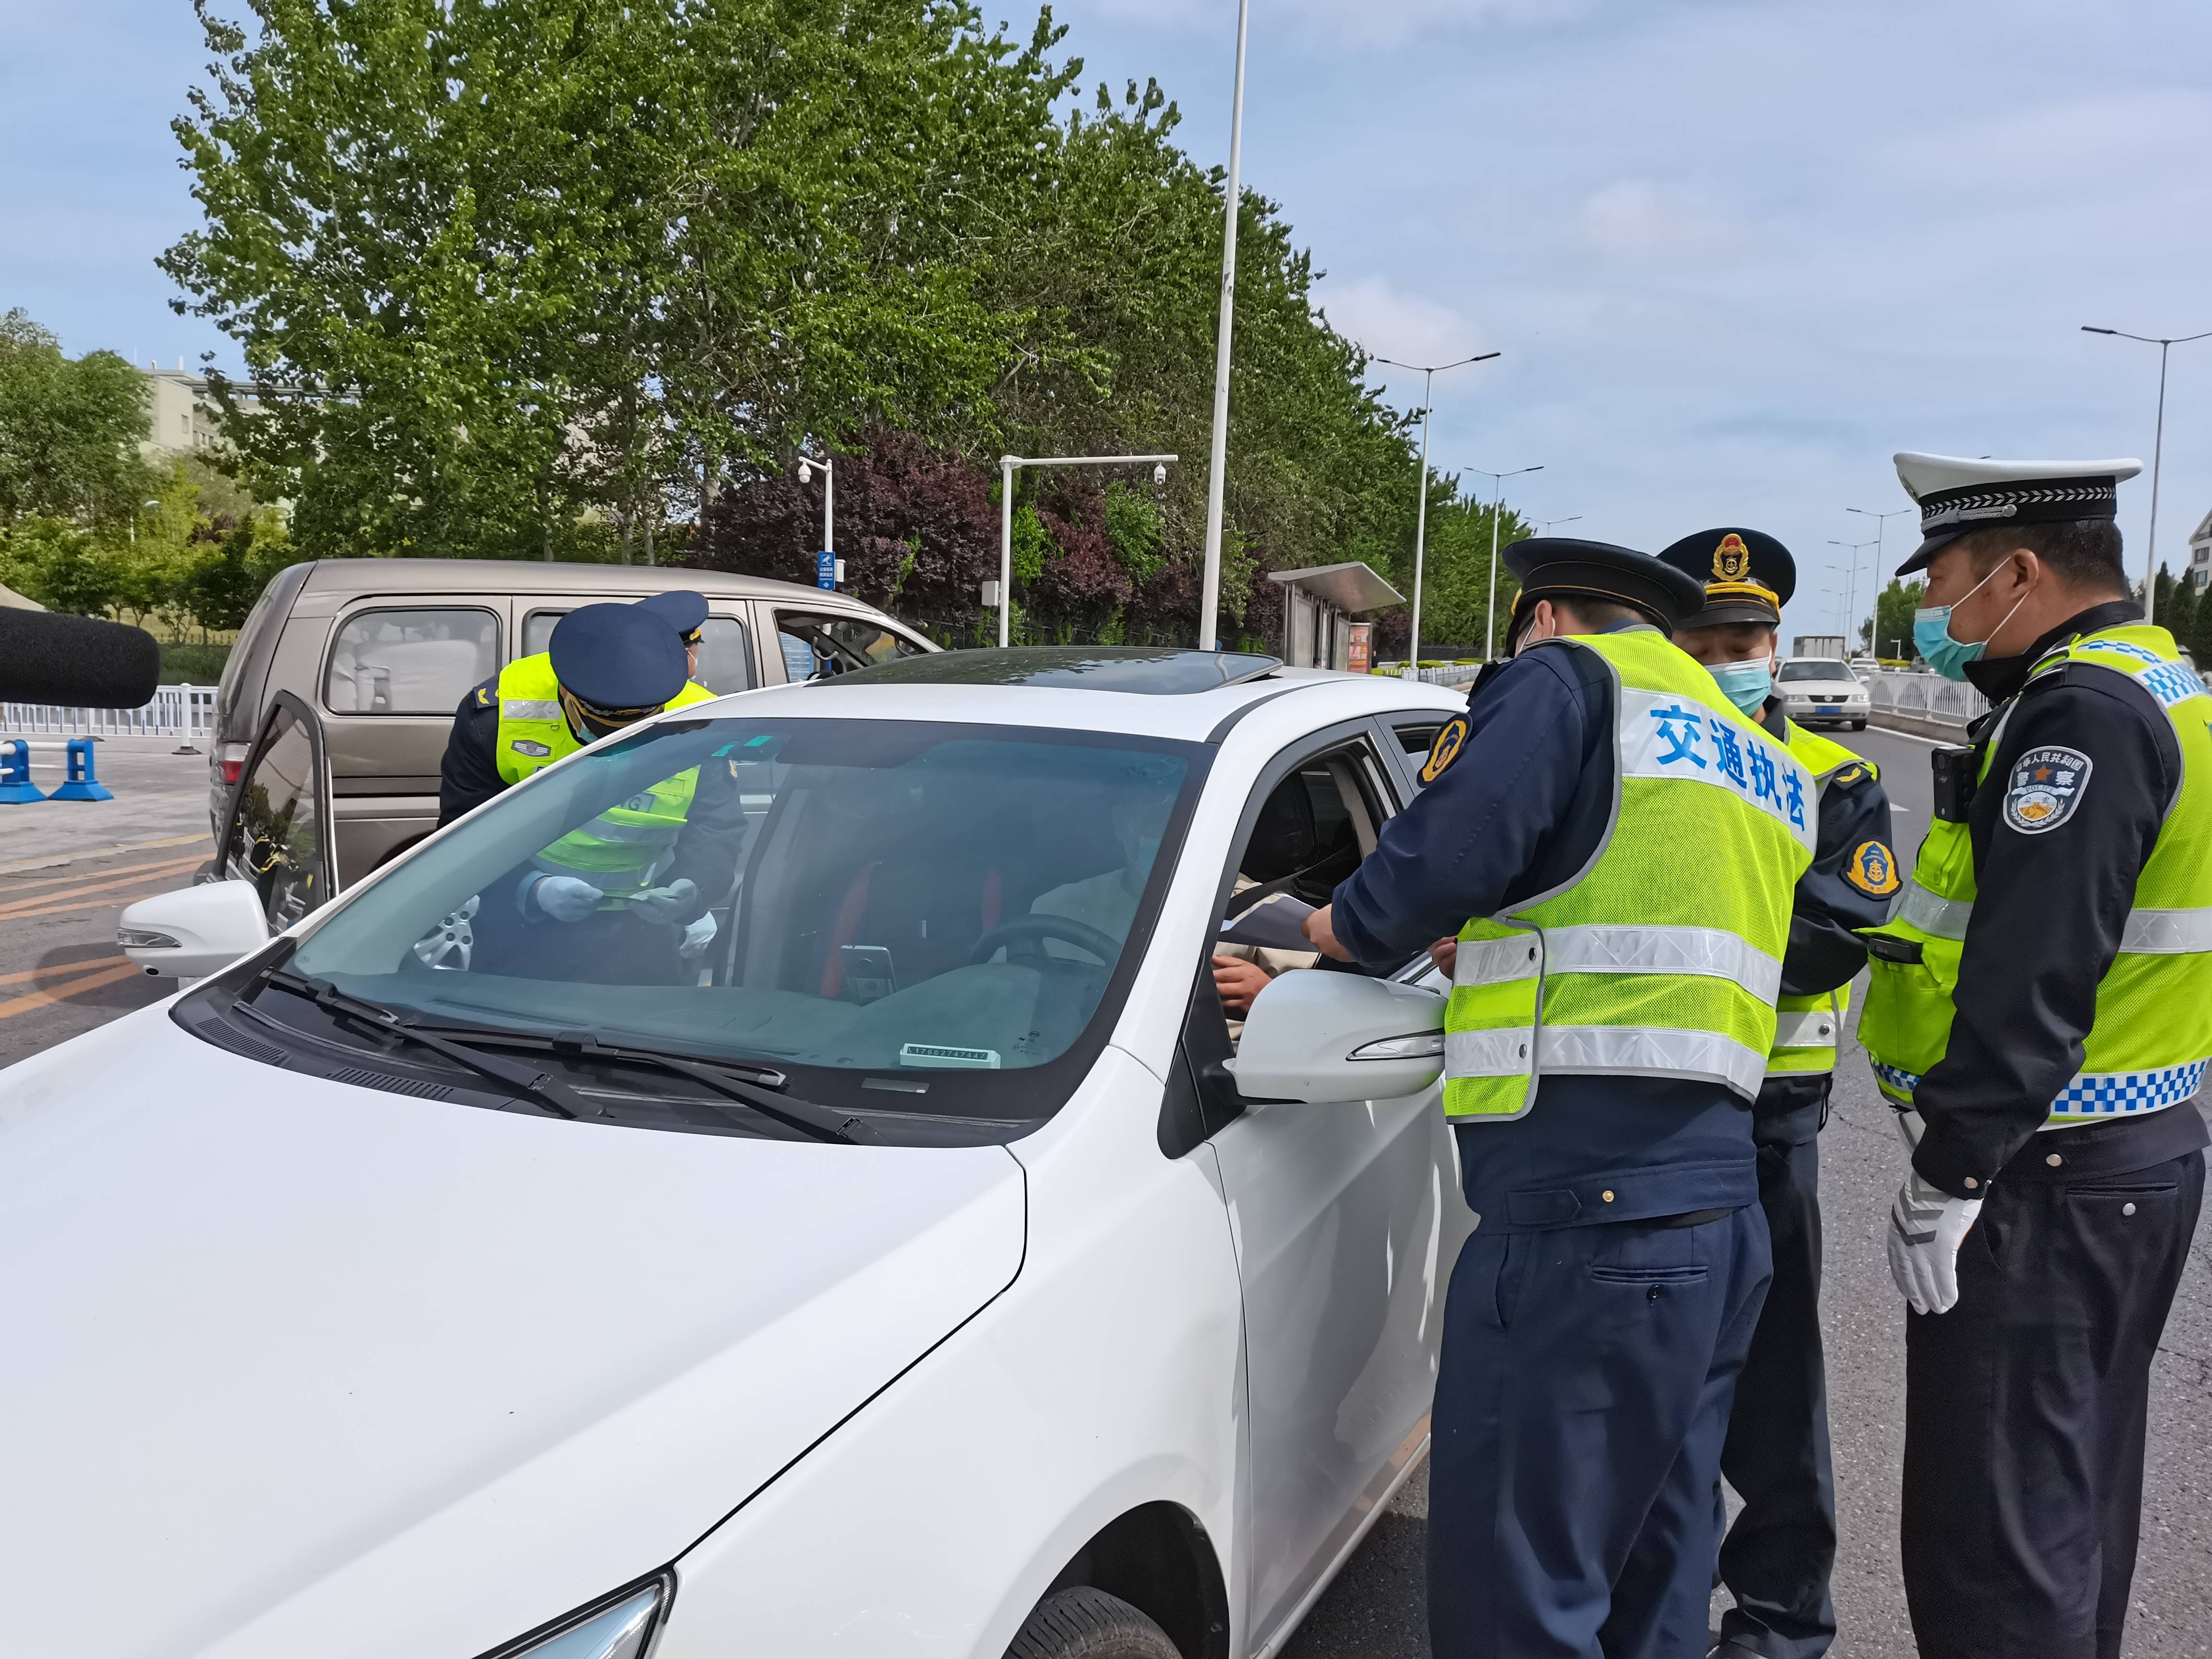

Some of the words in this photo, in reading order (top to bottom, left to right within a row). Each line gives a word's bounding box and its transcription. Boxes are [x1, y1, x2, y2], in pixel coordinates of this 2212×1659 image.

[1650, 705, 1804, 831] 交通执法
[2017, 752, 2084, 772] 中华人民共和国
[2017, 771, 2075, 787] 警察
[2025, 785, 2055, 793] POLICE
